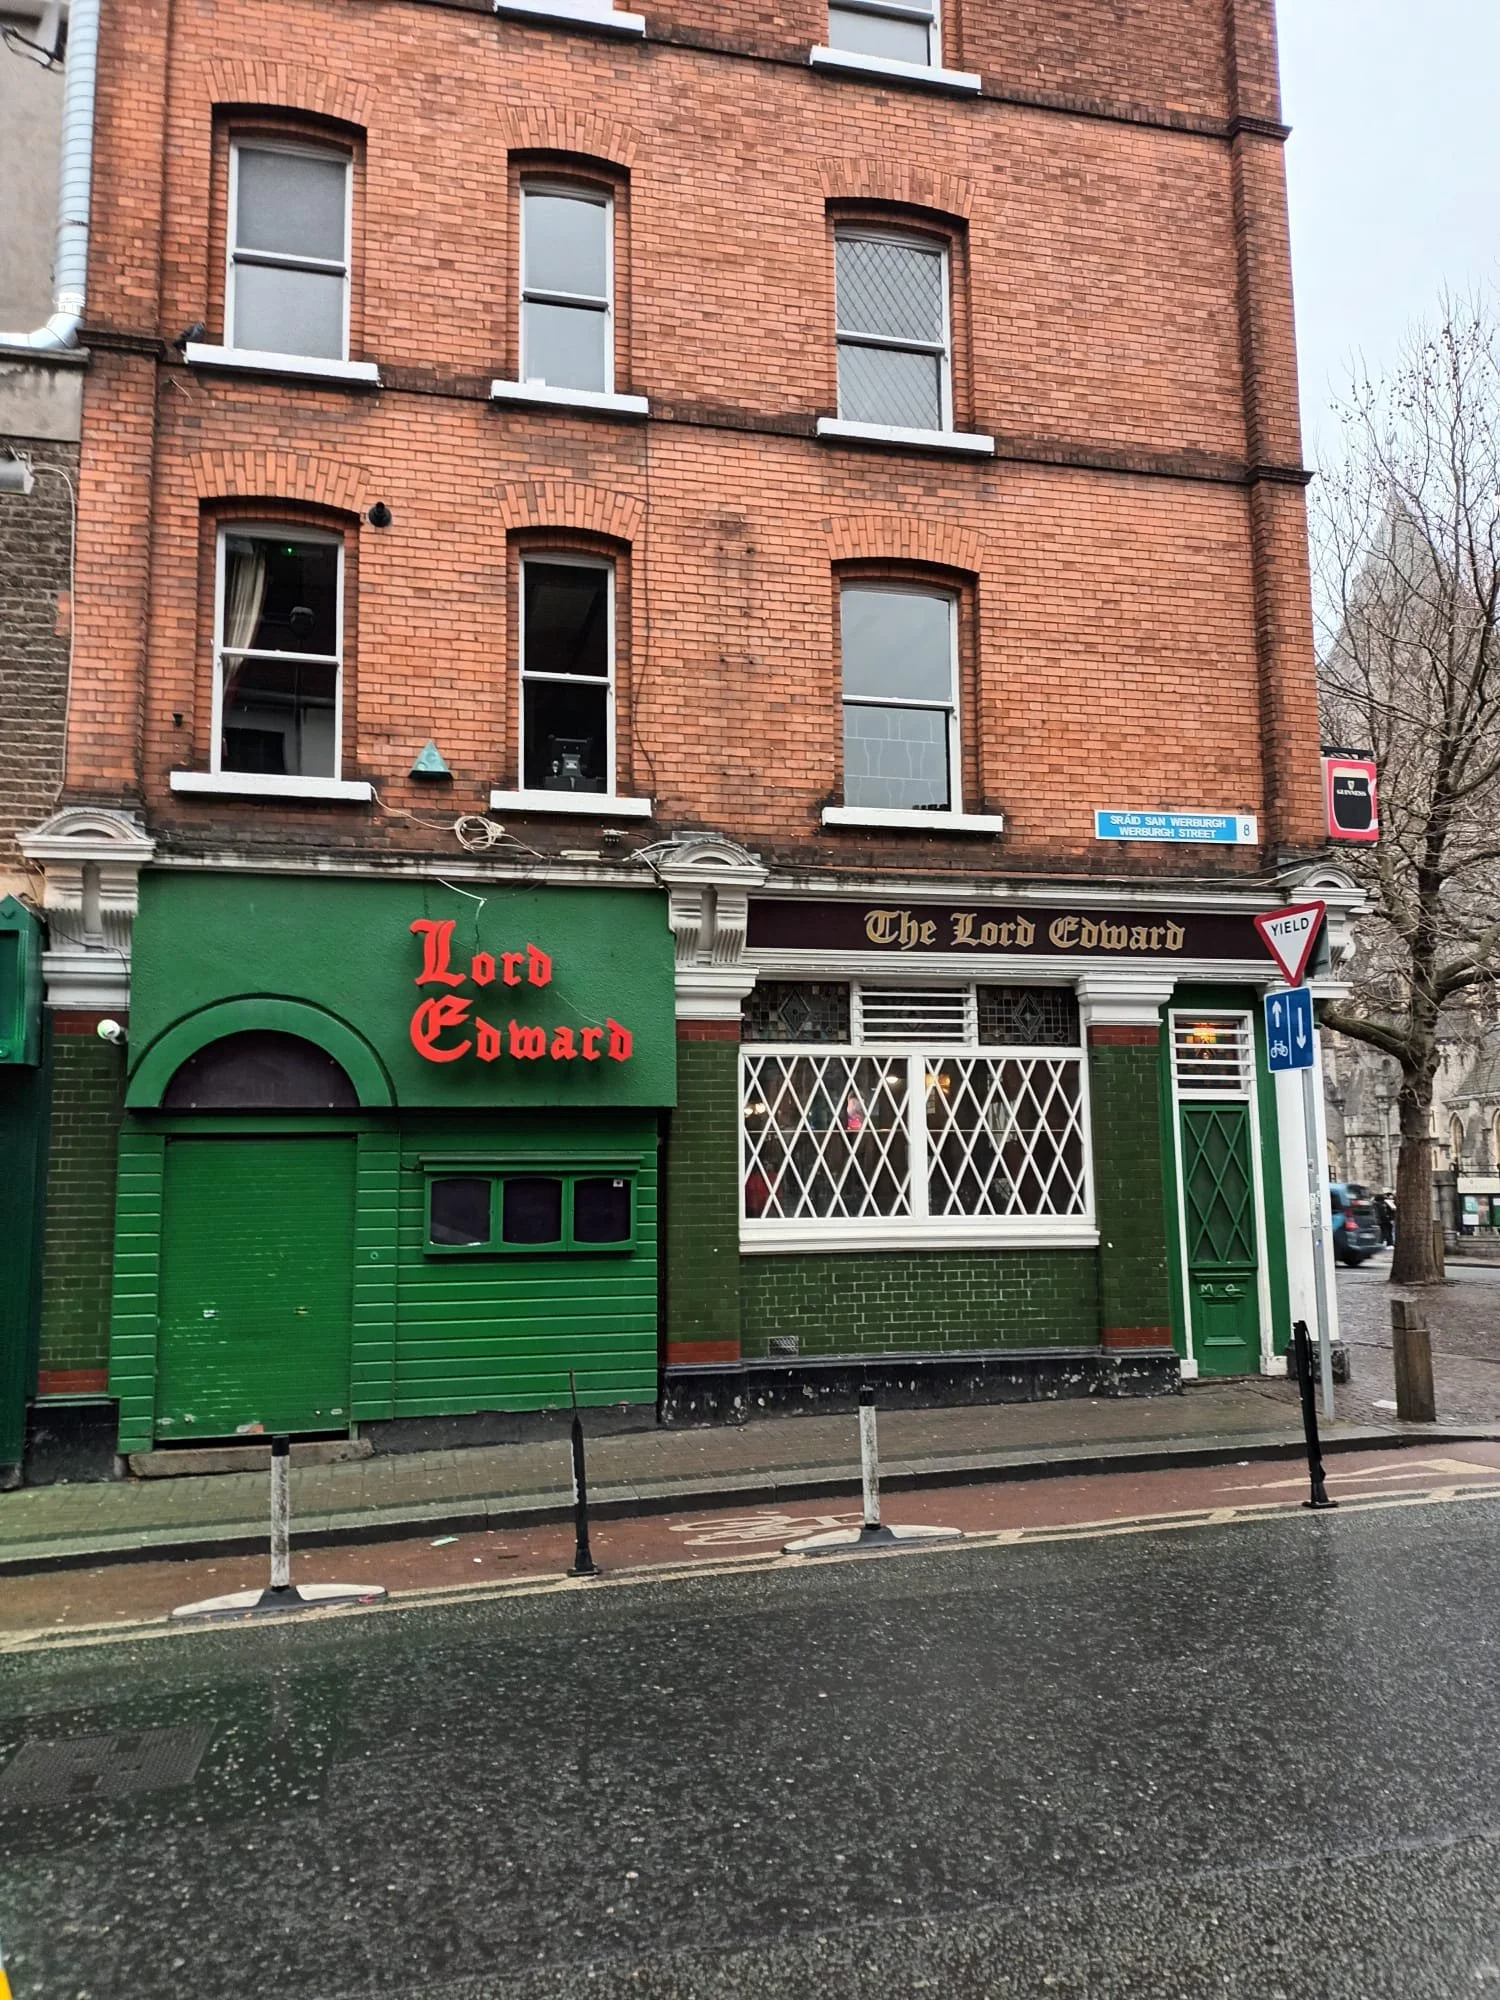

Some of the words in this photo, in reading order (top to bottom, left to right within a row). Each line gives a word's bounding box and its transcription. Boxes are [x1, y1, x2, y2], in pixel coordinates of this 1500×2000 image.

[1110, 814, 1141, 825] SRÁID
[1144, 817, 1166, 827] SAN
[1170, 818, 1226, 828] WERBURGH
[1243, 824, 1251, 837] 8
[1119, 827, 1175, 838] WERBURGH
[1178, 828, 1217, 839] STREET
[864, 910, 937, 950] The
[950, 912, 1036, 947] Lord
[1049, 915, 1185, 951] Edward
[1271, 917, 1309, 936] YIELD
[409, 919, 552, 988] Lord
[410, 994, 633, 1063] Edward
